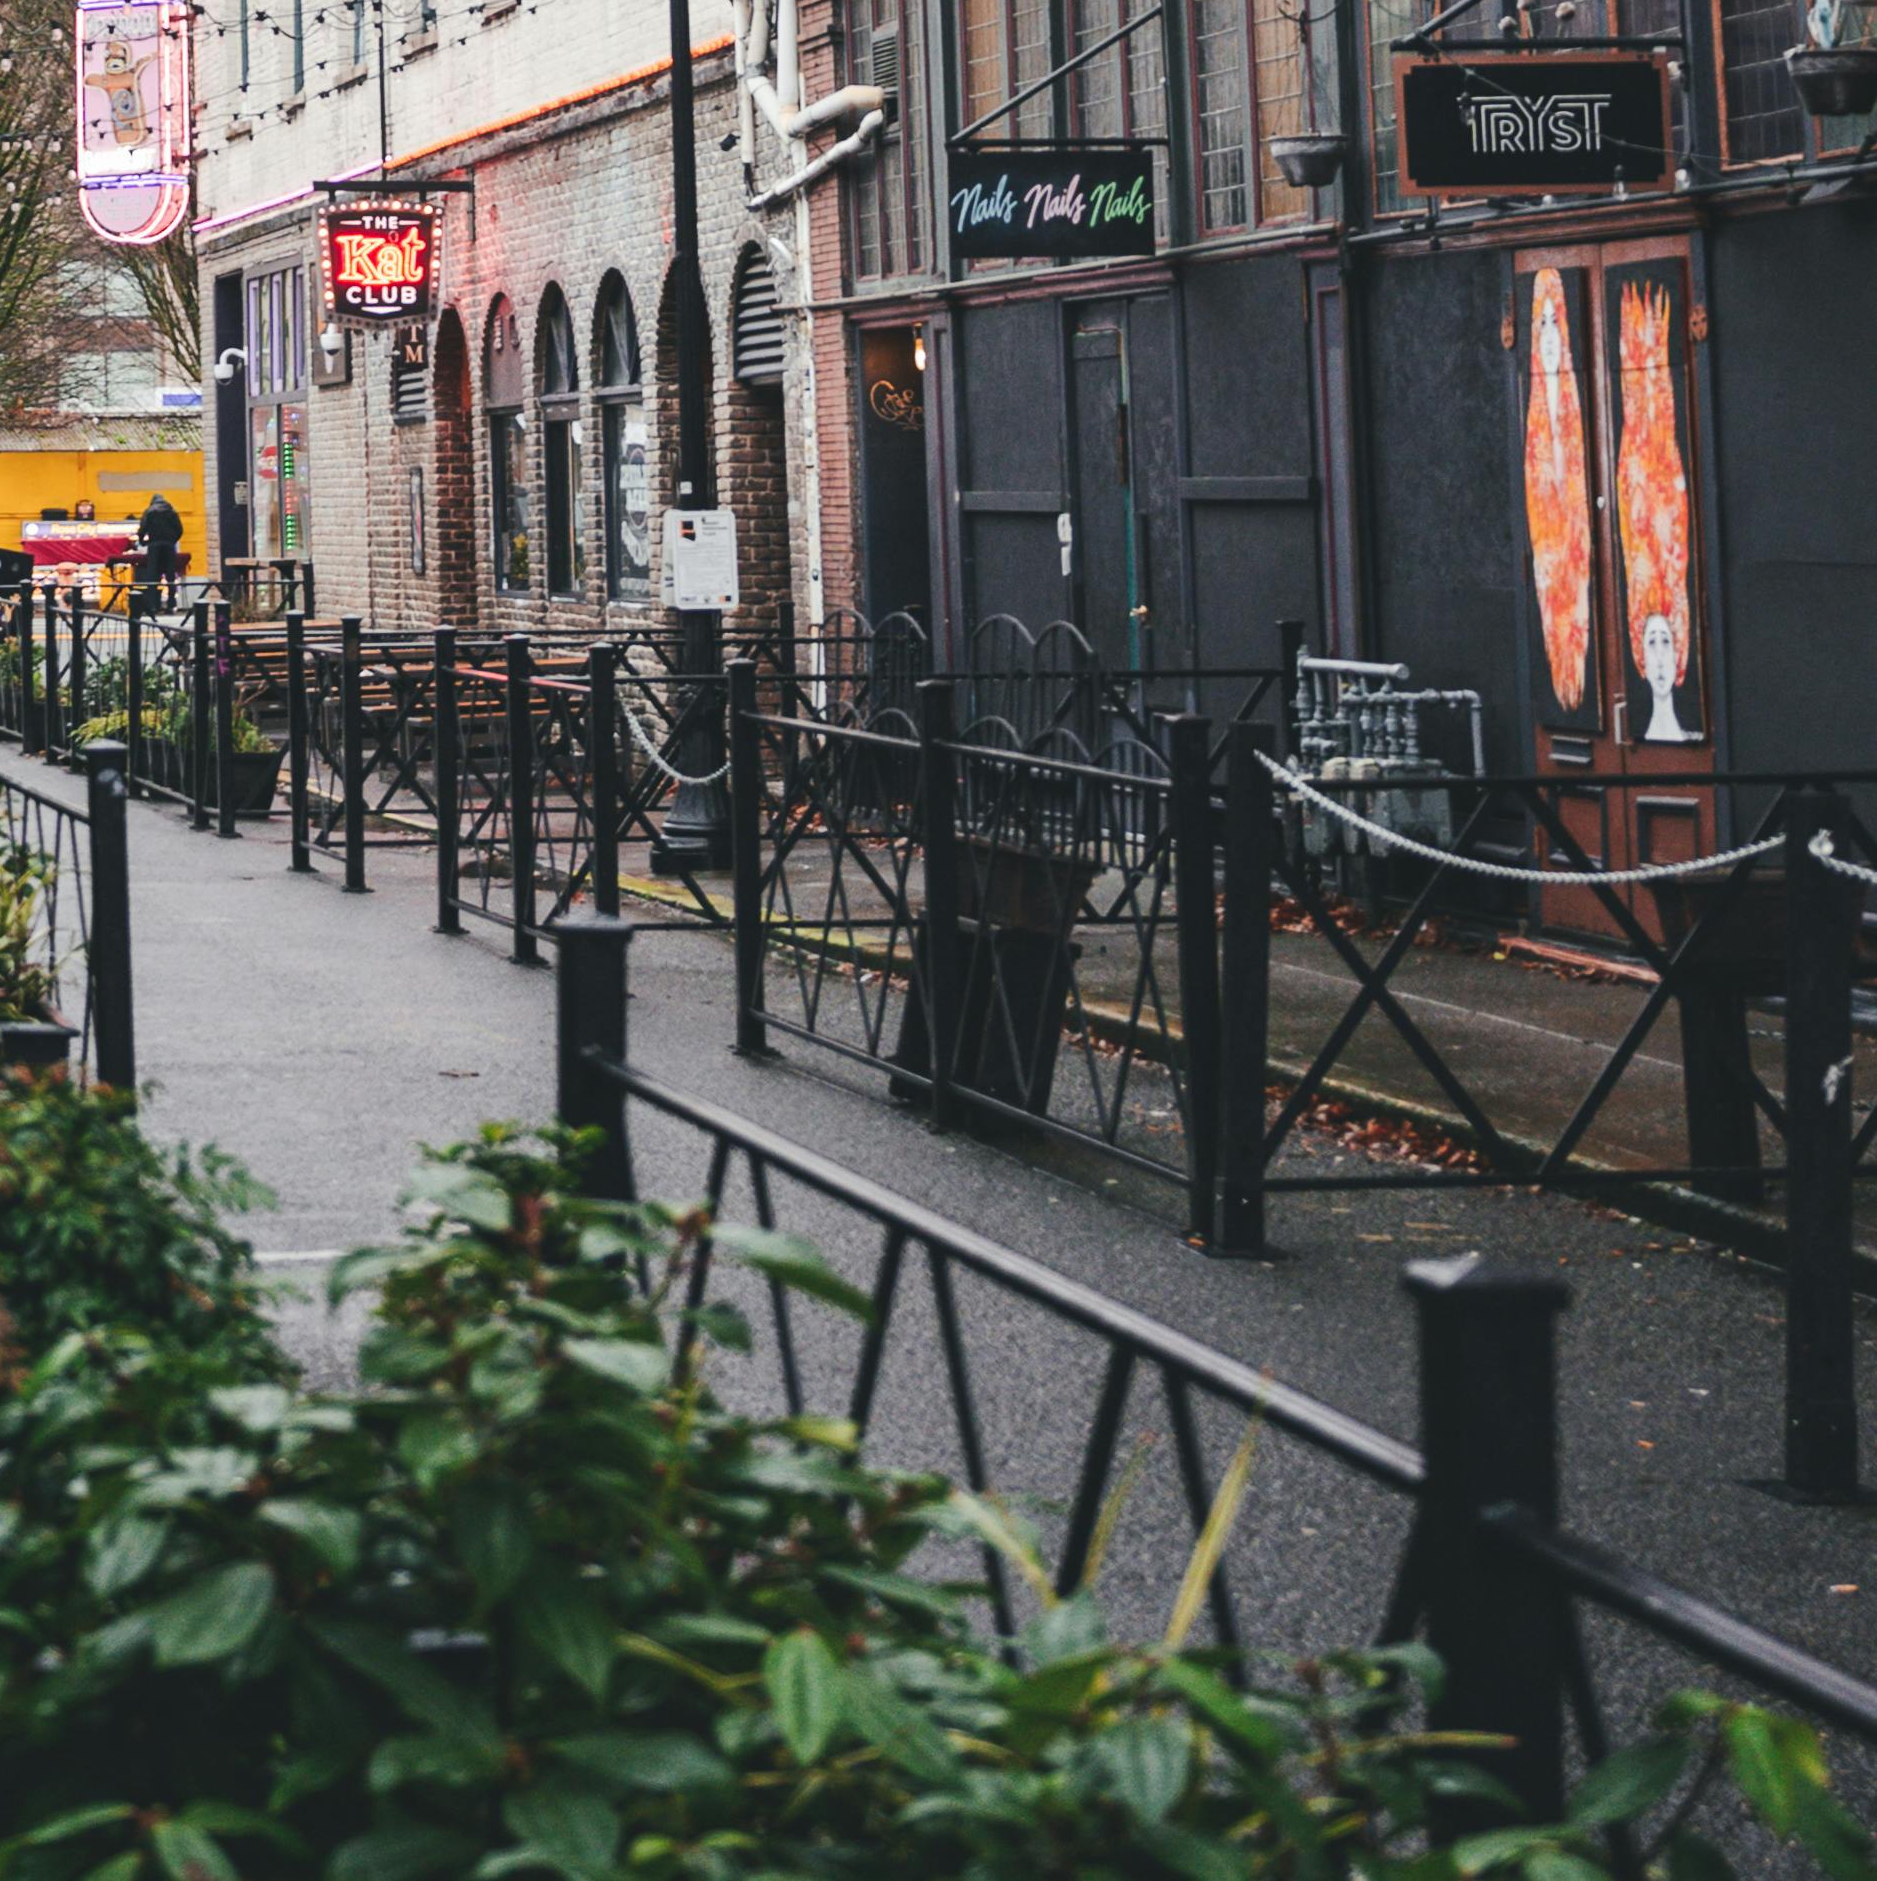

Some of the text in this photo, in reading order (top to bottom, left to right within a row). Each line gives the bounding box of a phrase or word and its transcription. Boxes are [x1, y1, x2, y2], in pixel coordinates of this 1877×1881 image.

[1461, 93, 1612, 153] TRYST
[362, 216, 399, 230] THE
[950, 173, 1152, 233] Nails Nails Nails
[335, 227, 426, 284] Kat
[346, 286, 418, 304] CLUB
